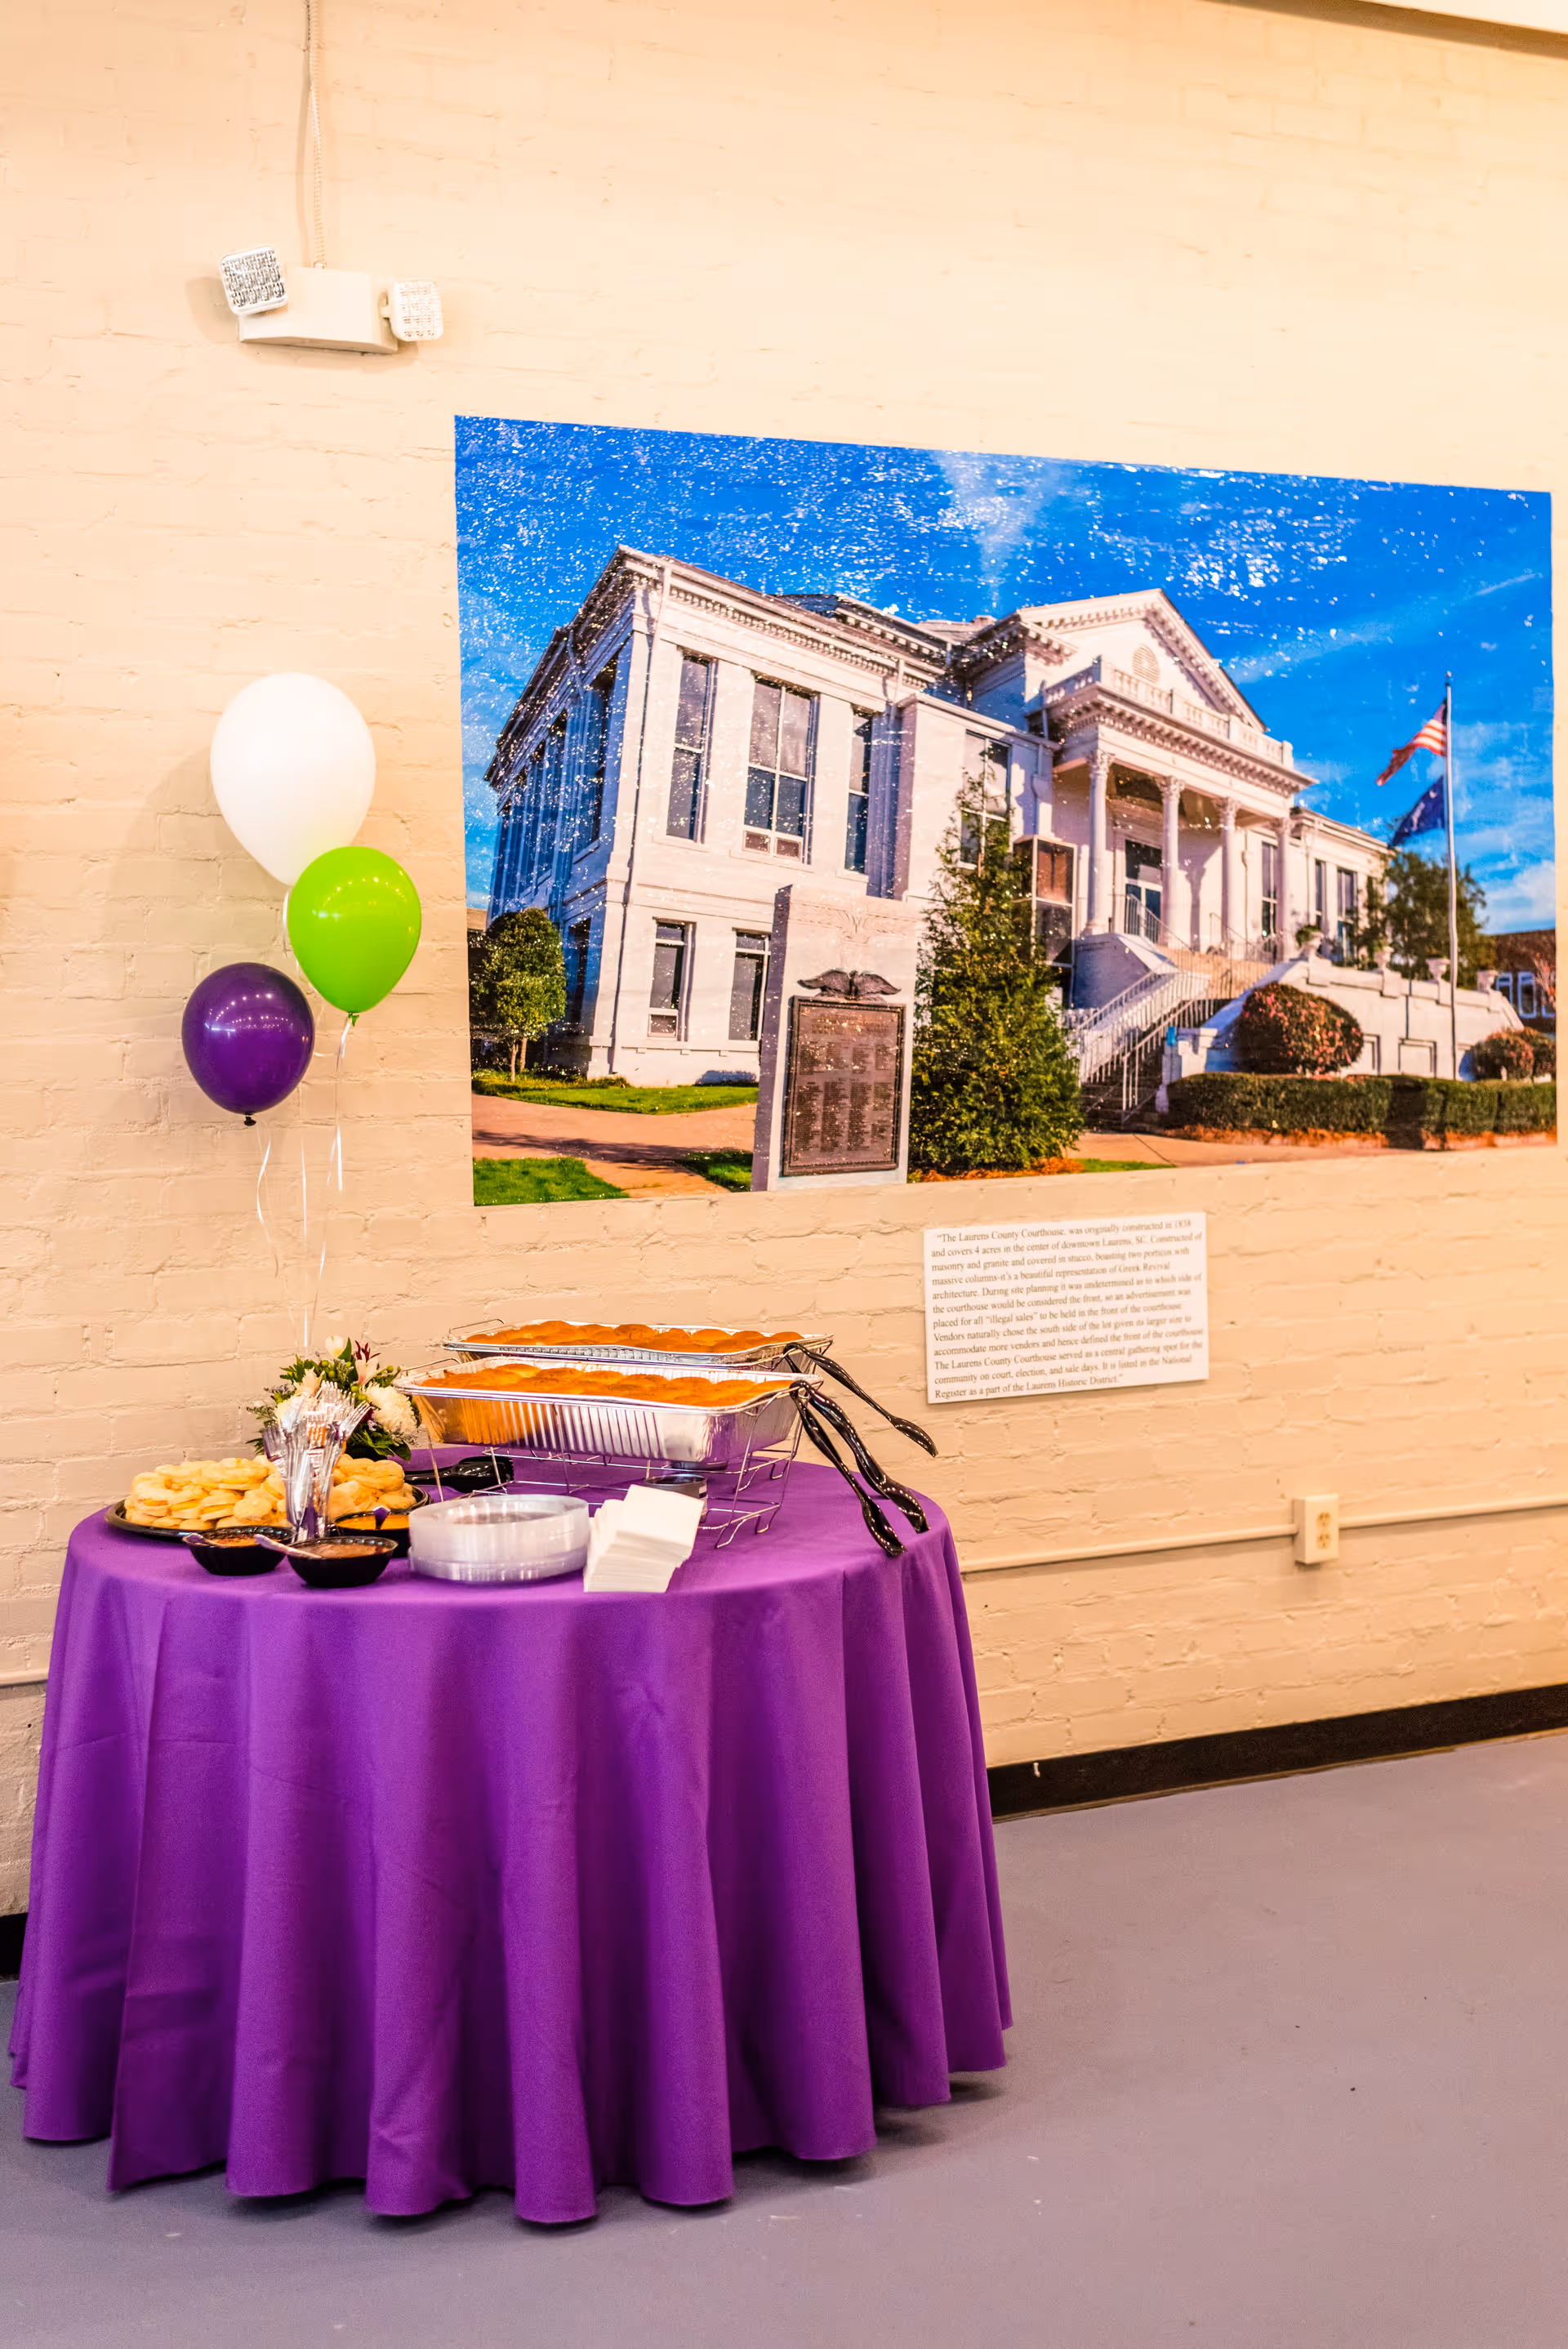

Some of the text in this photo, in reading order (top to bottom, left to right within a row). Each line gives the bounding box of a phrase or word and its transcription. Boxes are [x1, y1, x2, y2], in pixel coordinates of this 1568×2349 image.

[959, 1232, 989, 1241] Laurens
[991, 1231, 1018, 1241] County
[1085, 1224, 1120, 1234] originally
[1122, 1222, 1163, 1232] constructed
[932, 1249, 945, 1257] and
[947, 1248, 973, 1256] covers
[974, 1246, 979, 1255] 4
[982, 1246, 1001, 1255] acres
[1004, 1245, 1011, 1253] in
[1013, 1244, 1025, 1252] the
[1027, 1242, 1049, 1251] center
[1052, 1241, 1060, 1250] of
[1062, 1239, 1100, 1249] downtown
[1151, 1232, 1193, 1243] Constructed
[1195, 1232, 1202, 1241] of
[932, 1262, 964, 1271] masonry
[967, 1259, 981, 1268] and
[983, 1259, 1009, 1270] granite
[1011, 1257, 1025, 1266] and
[1027, 1255, 1056, 1265] covered
[1058, 1255, 1066, 1263] in
[1095, 1251, 1125, 1261] boasting
[1174, 1246, 1190, 1255] with
[933, 1277, 963, 1286] massive
[1020, 1269, 1053, 1279] beautiful
[1055, 1267, 1107, 1278] representation
[1109, 1264, 1116, 1273] of
[1143, 1262, 1170, 1270] Revival
[982, 1287, 1009, 1297] During
[1027, 1285, 1058, 1295] planning
[1061, 1283, 1066, 1291] it
[1085, 1278, 1134, 1289] undetermined
[1178, 1273, 1192, 1281] side
[1194, 1273, 1202, 1281] of
[933, 1304, 945, 1313] the
[947, 1304, 988, 1313] courthouse
[991, 1299, 1014, 1309] would
[1016, 1299, 1025, 1308] be
[1027, 1296, 1067, 1307] considered
[1070, 1294, 1080, 1303] the
[933, 1318, 958, 1330] placed
[961, 1317, 971, 1326] for
[973, 1316, 983, 1325] all
[1049, 1311, 1058, 1319] be
[1060, 1308, 1076, 1317] held
[1087, 1308, 1098, 1316] the
[1101, 1307, 1118, 1315] front
[1120, 1305, 1129, 1313] of
[1130, 1304, 1141, 1313] the
[933, 1333, 964, 1342] Vendors
[967, 1330, 1000, 1340] naturally
[1003, 1328, 1024, 1337] chose
[1027, 1326, 1038, 1335] the
[1040, 1325, 1060, 1333] south
[1062, 1324, 1076, 1332] side
[1079, 1322, 1087, 1330] of
[1089, 1321, 1099, 1330] the
[1102, 1320, 1111, 1329] lot
[1113, 1320, 1134, 1330] given
[934, 1345, 987, 1356] accommodate
[1010, 1341, 1040, 1350] vendors
[1042, 1338, 1056, 1347] and
[1058, 1337, 1078, 1346] hence
[1080, 1335, 1108, 1344] defined
[1110, 1333, 1121, 1342] the
[1124, 1331, 1141, 1340] front
[1143, 1331, 1151, 1339] of
[1152, 1330, 1164, 1339] the
[935, 1361, 949, 1370] The
[951, 1359, 982, 1369] Laurens
[984, 1357, 1011, 1366] County
[1014, 1353, 1057, 1364] Courthouse
[1058, 1349, 1083, 1360] served
[1101, 1347, 1125, 1356] central
[1128, 1345, 1160, 1357] gathering
[1163, 1344, 1178, 1353] spot
[935, 1374, 978, 1384] community
[1049, 1365, 1062, 1375] and
[1102, 1362, 1108, 1370] It
[1119, 1359, 1138, 1368] listed
[1149, 1357, 1160, 1366] the
[1162, 1353, 1192, 1365] National
[935, 1389, 966, 1399] Register
[986, 1384, 1000, 1396] part
[1003, 1383, 1011, 1392] of
[1013, 1382, 1025, 1392] the
[1027, 1380, 1056, 1390] Laurens
[1058, 1377, 1087, 1388] Historic
